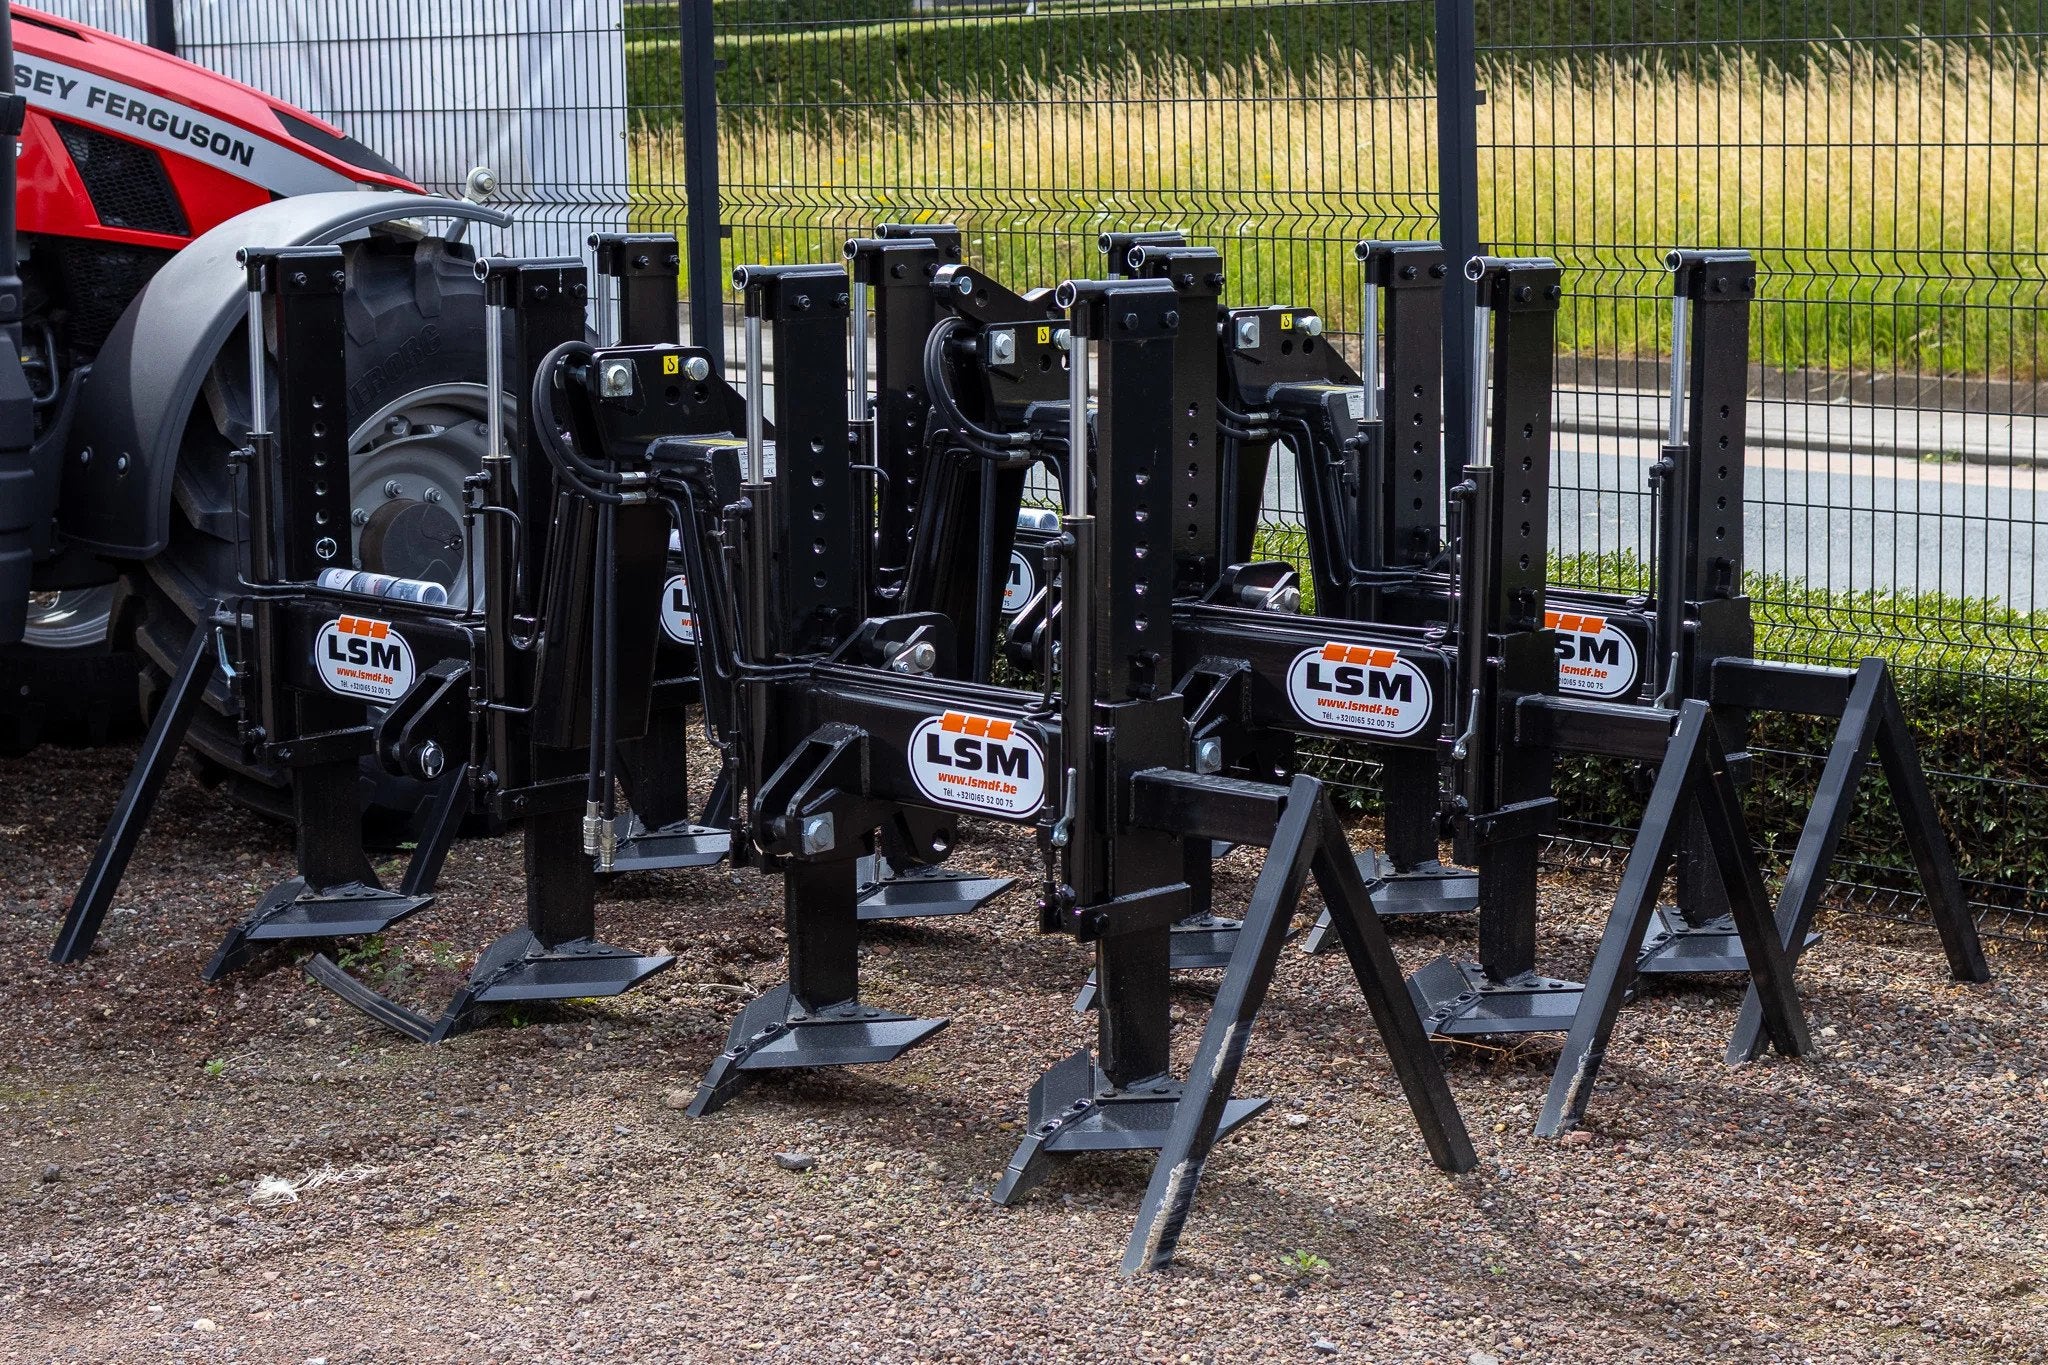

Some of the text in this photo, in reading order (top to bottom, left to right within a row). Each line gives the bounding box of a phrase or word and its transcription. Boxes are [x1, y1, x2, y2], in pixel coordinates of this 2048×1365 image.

[14, 63, 255, 167] SEY FERGUSON
[327, 633, 402, 672] LSM
[1555, 632, 1620, 666] SM
[336, 666, 394, 685] www.lsmdf.be
[1306, 661, 1413, 703] LSM
[371, 686, 378, 694] 52
[1317, 697, 1400, 717] www.lsmdf.be
[1367, 717, 1375, 726] 52
[1376, 719, 1385, 728] 00
[1386, 720, 1395, 729] 75
[926, 732, 1030, 780] LSM
[938, 772, 1018, 795] www.lsmdf.be
[986, 795, 994, 805] 52
[995, 797, 1004, 807] 00
[1005, 799, 1014, 808] 75
